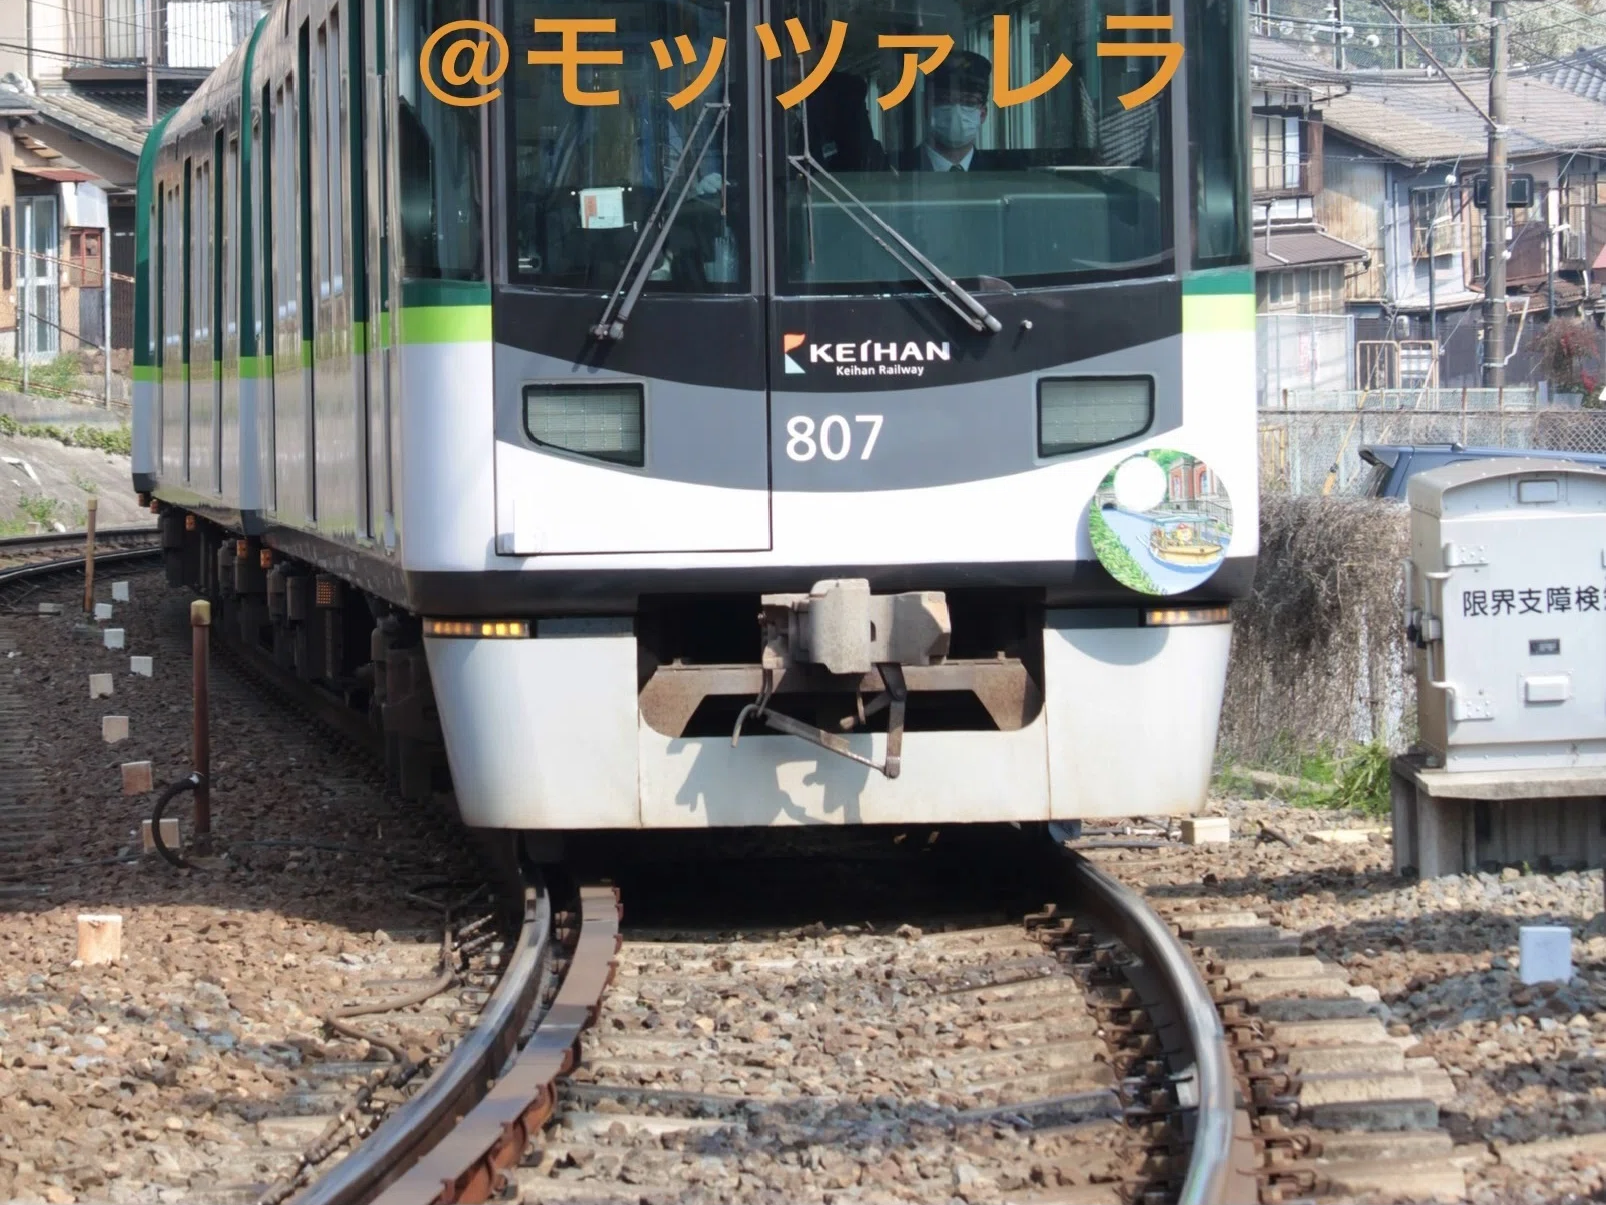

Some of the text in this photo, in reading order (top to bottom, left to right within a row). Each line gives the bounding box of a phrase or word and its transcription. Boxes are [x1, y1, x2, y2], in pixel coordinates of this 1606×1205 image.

[809, 339, 951, 363] KEIHAN
[836, 364, 924, 377] Keihan Railway
[786, 414, 884, 462] 807
[1463, 585, 1606, 617] 限界支障検
